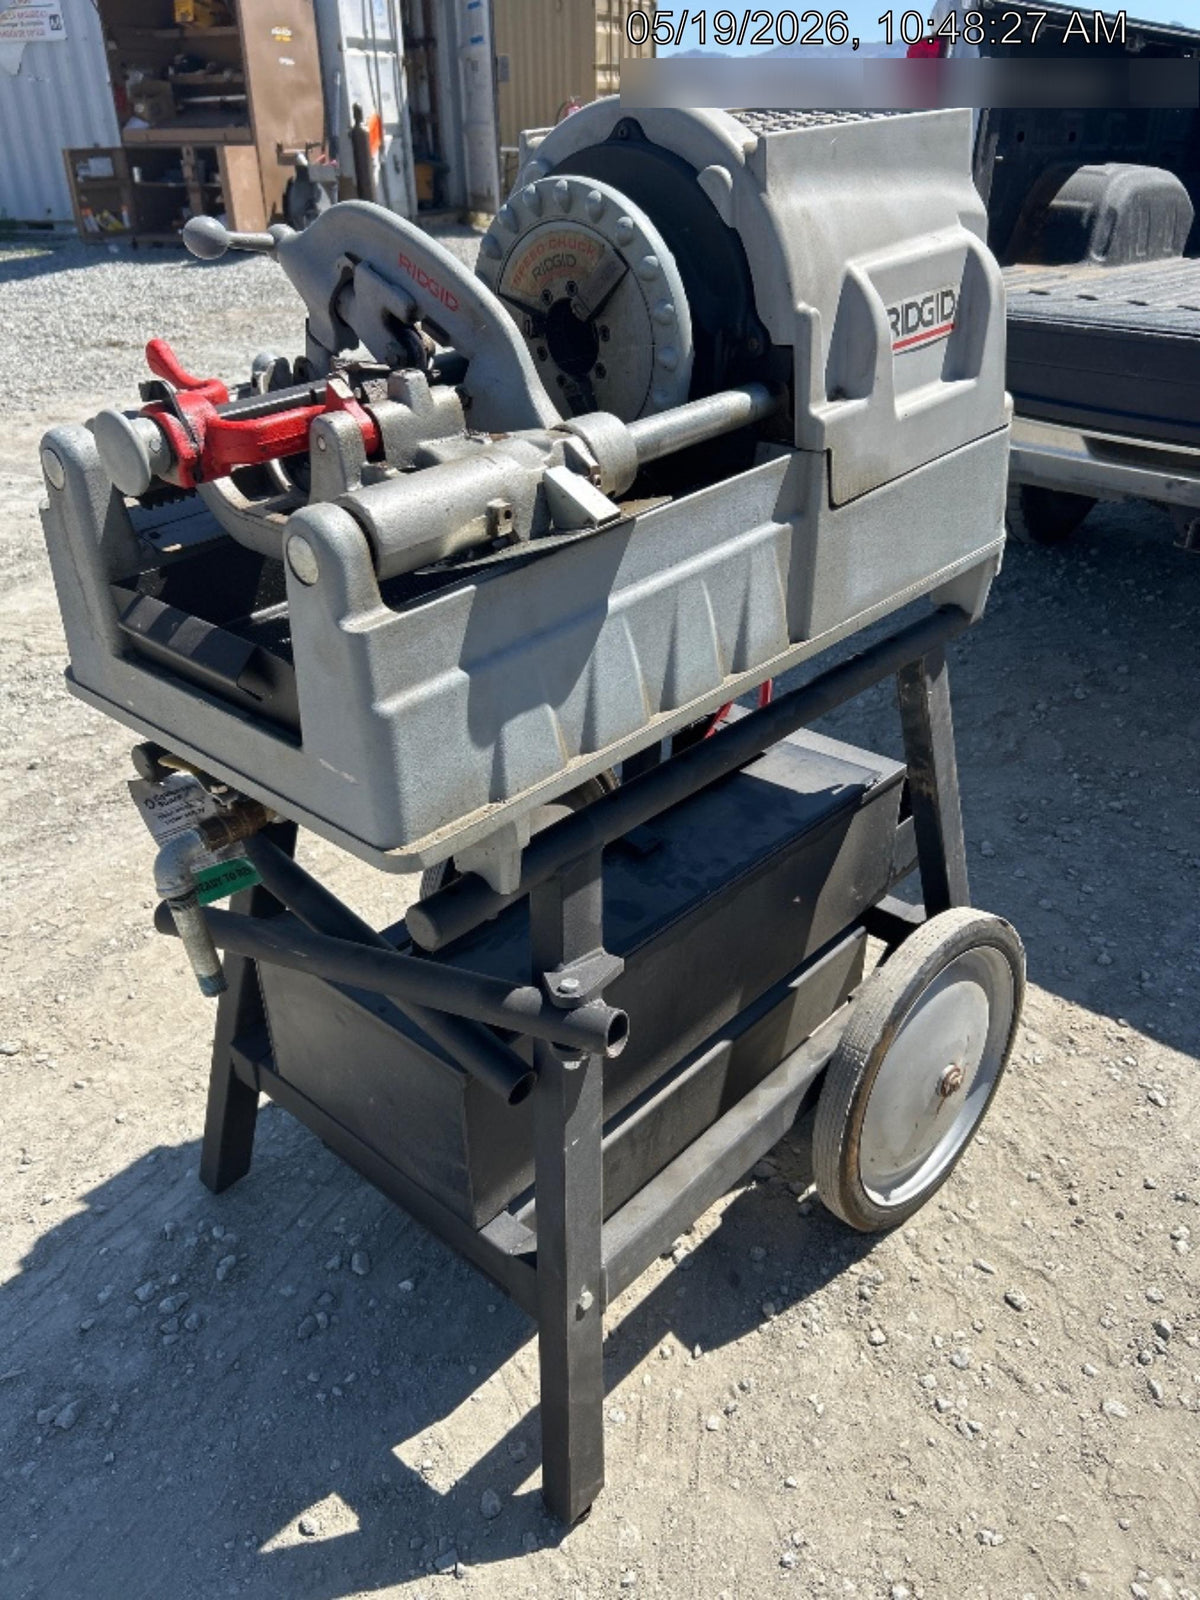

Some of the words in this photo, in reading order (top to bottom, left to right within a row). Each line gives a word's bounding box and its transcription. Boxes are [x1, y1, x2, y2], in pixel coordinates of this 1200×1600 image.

[398, 252, 459, 311] RIDGID
[531, 252, 577, 281] RIDGID
[886, 289, 955, 337] RIDGID
